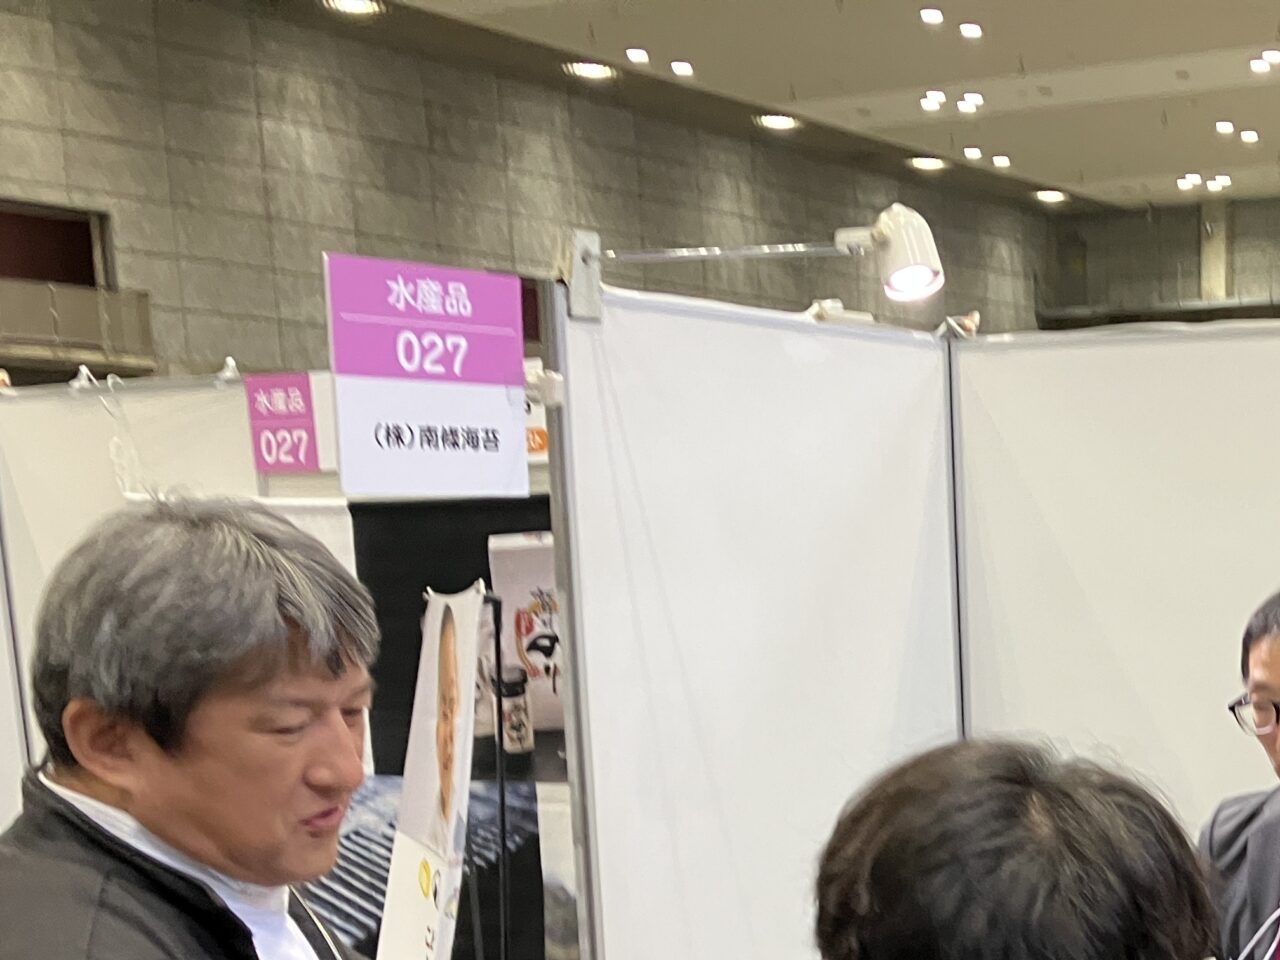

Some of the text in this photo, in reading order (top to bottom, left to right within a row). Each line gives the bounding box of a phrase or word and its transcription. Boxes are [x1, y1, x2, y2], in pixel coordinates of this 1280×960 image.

[386, 274, 472, 317] 水産品
[396, 330, 468, 377] 027
[254, 387, 306, 416] 水産品
[260, 428, 309, 465] 027
